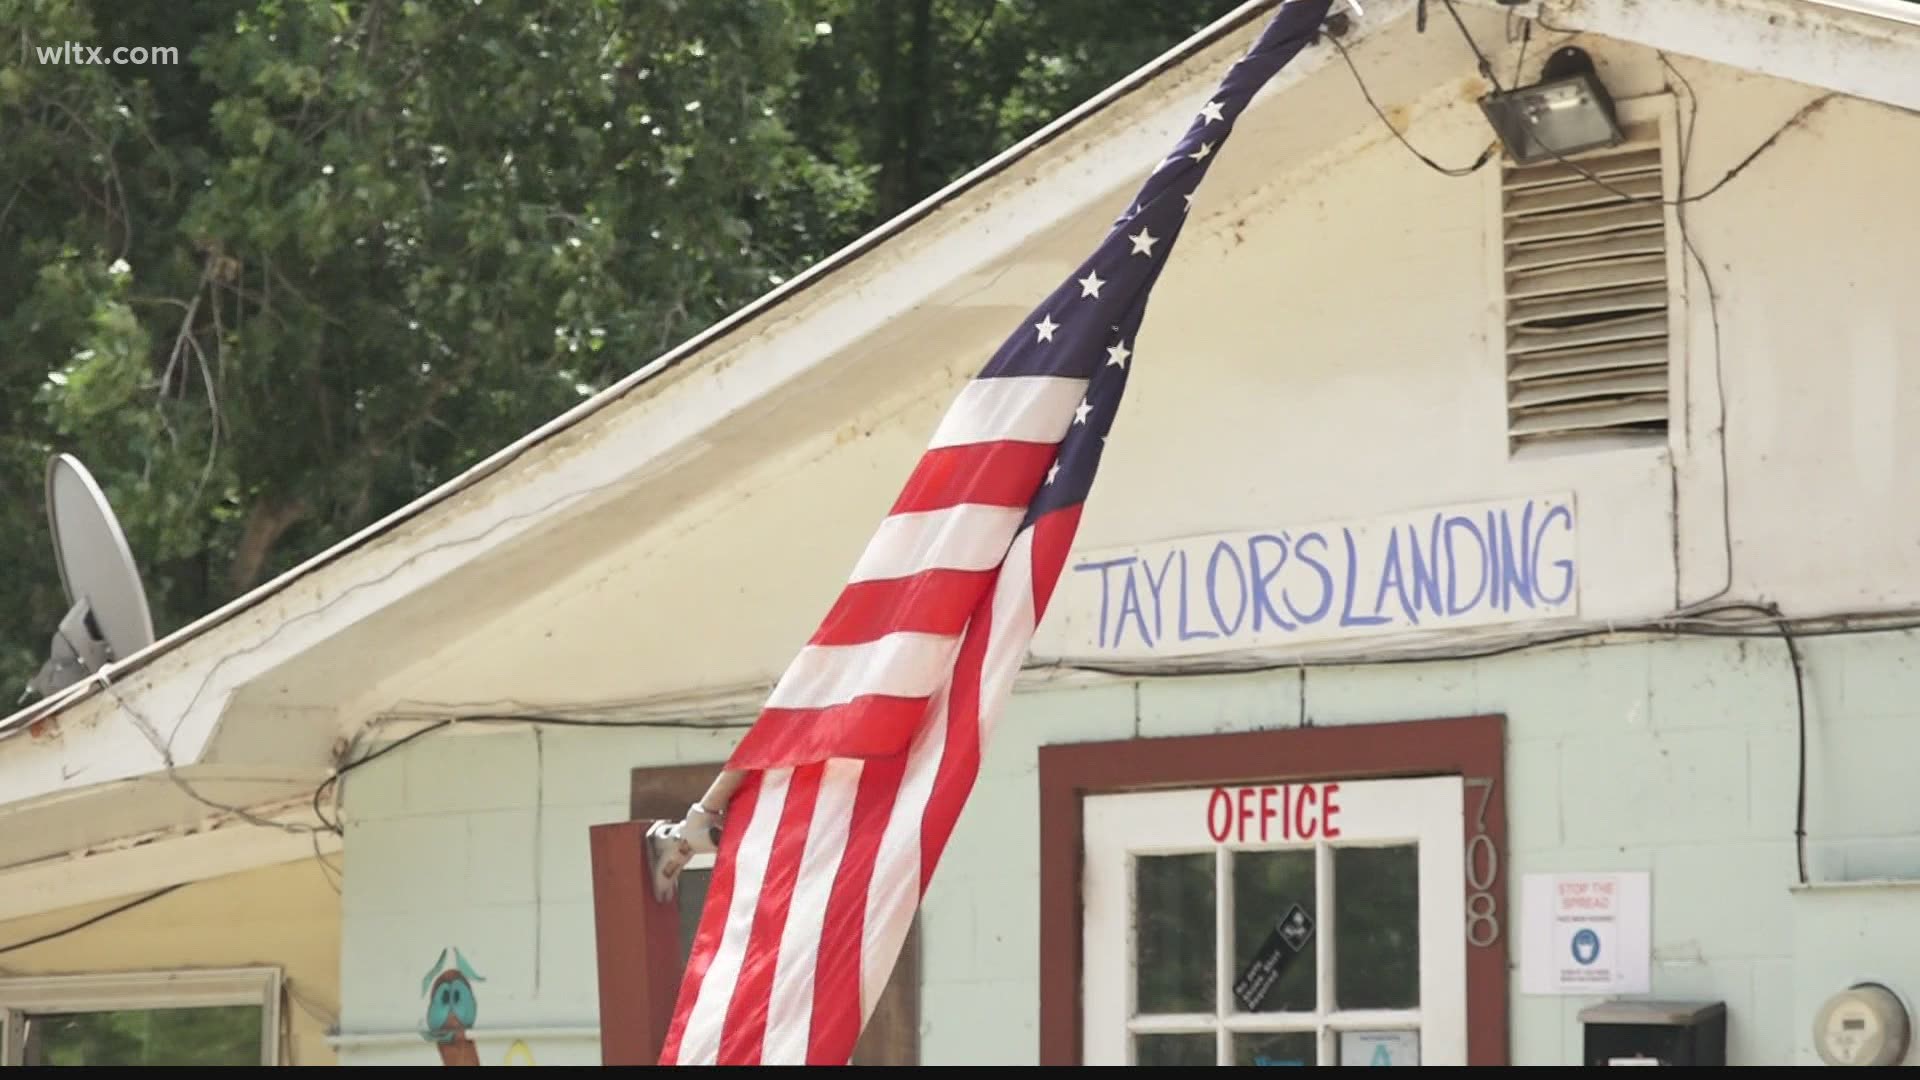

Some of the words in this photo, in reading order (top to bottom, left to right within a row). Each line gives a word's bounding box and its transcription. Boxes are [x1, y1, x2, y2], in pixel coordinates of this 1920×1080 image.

[1074, 531, 1334, 648] TAYLOR'S
[1340, 500, 1574, 627] LANDING
[1207, 784, 1341, 842] OFFICE
[1464, 778, 1499, 947] 708
[1558, 881, 1588, 896] STOP
[1592, 881, 1614, 895] THE
[1561, 897, 1610, 909] SPREAD
